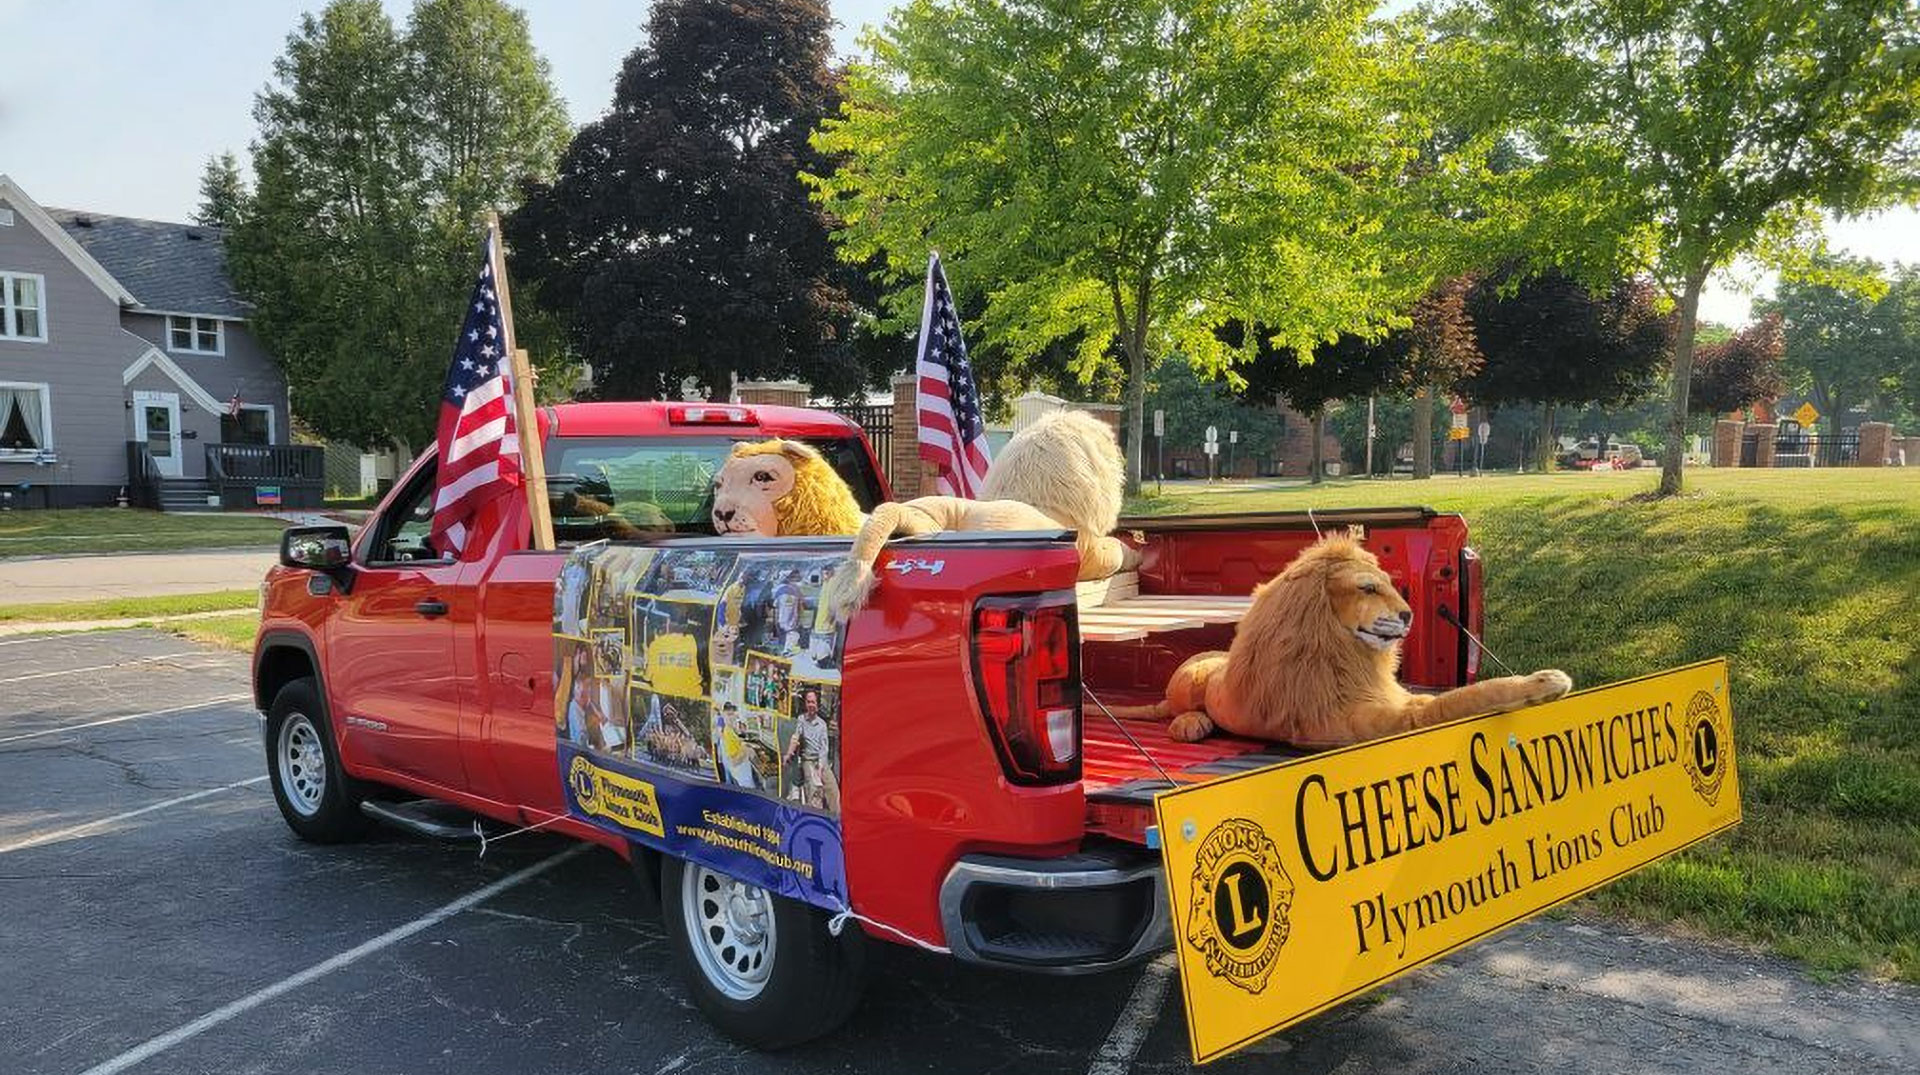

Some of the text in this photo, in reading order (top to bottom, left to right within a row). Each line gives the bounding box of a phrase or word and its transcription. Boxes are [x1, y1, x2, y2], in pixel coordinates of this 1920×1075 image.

[1698, 726, 1715, 768] L
[1295, 702, 1678, 882] CHEESE SANDWICHES
[1201, 827, 1260, 872] LIONS
[1351, 794, 1665, 960] Plymouth Lions Club
[1224, 873, 1262, 937] L
